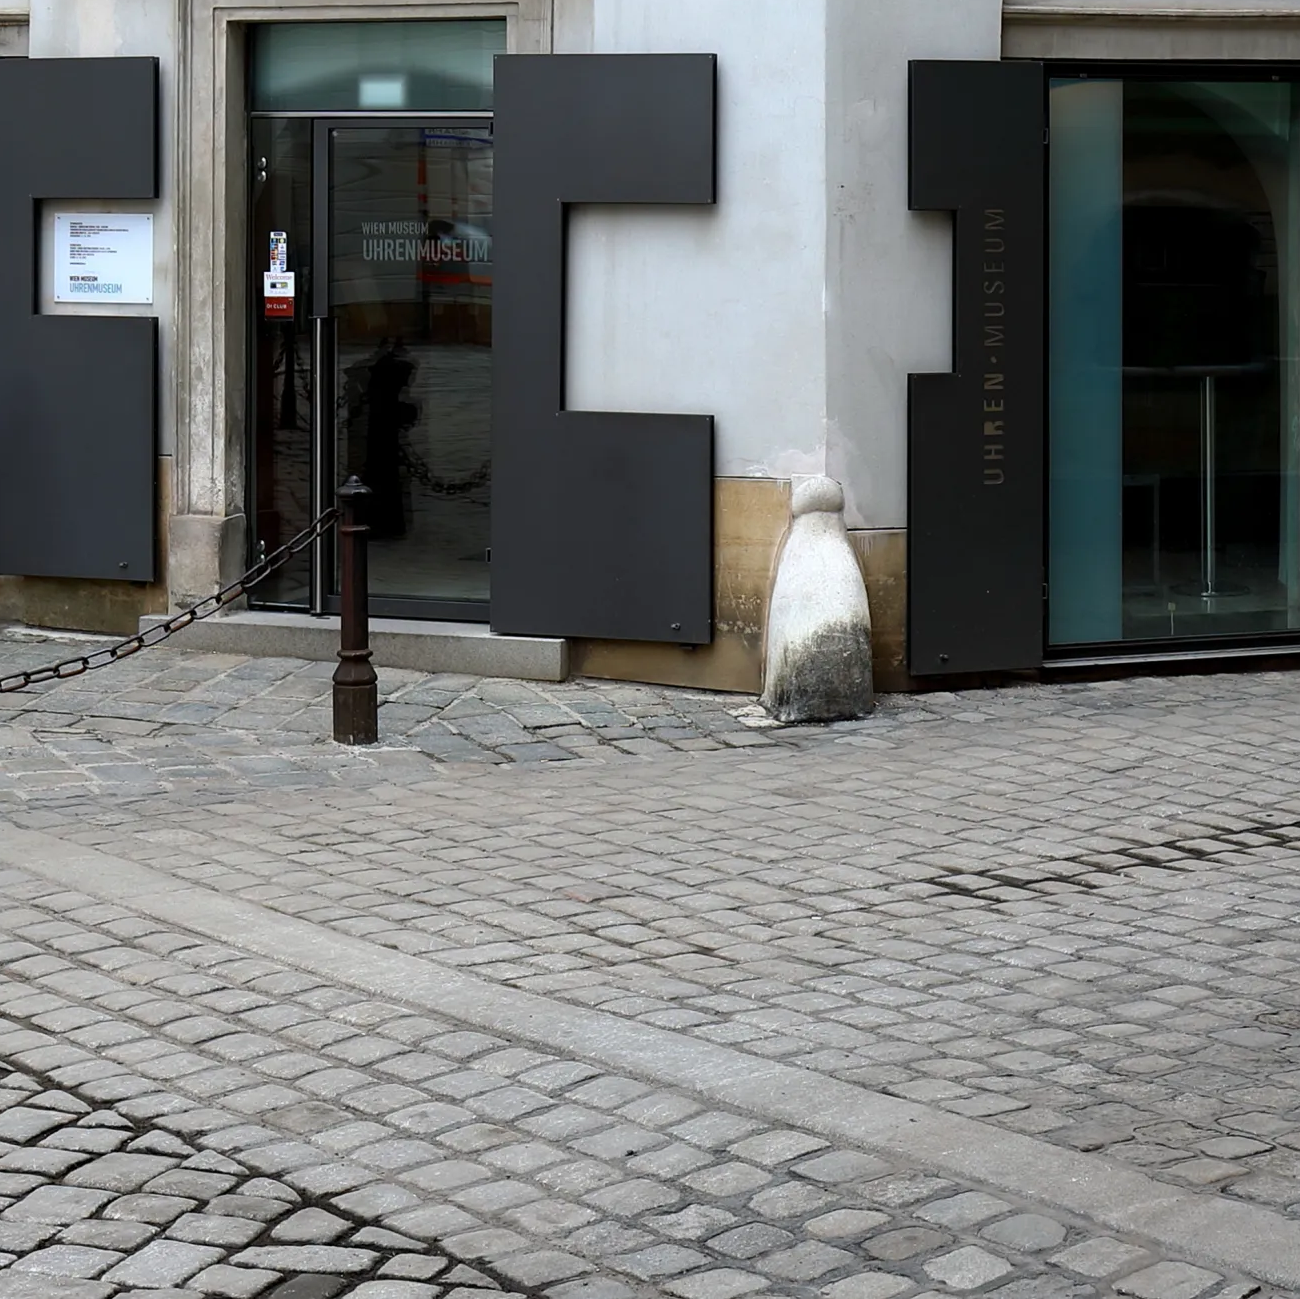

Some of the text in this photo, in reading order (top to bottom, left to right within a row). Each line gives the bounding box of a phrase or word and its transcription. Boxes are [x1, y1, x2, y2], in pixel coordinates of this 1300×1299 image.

[361, 221, 429, 235] WIEN MUSEUM
[362, 239, 488, 261] UHRENMUSEUM
[69, 283, 123, 294] UHRENMUSEUM
